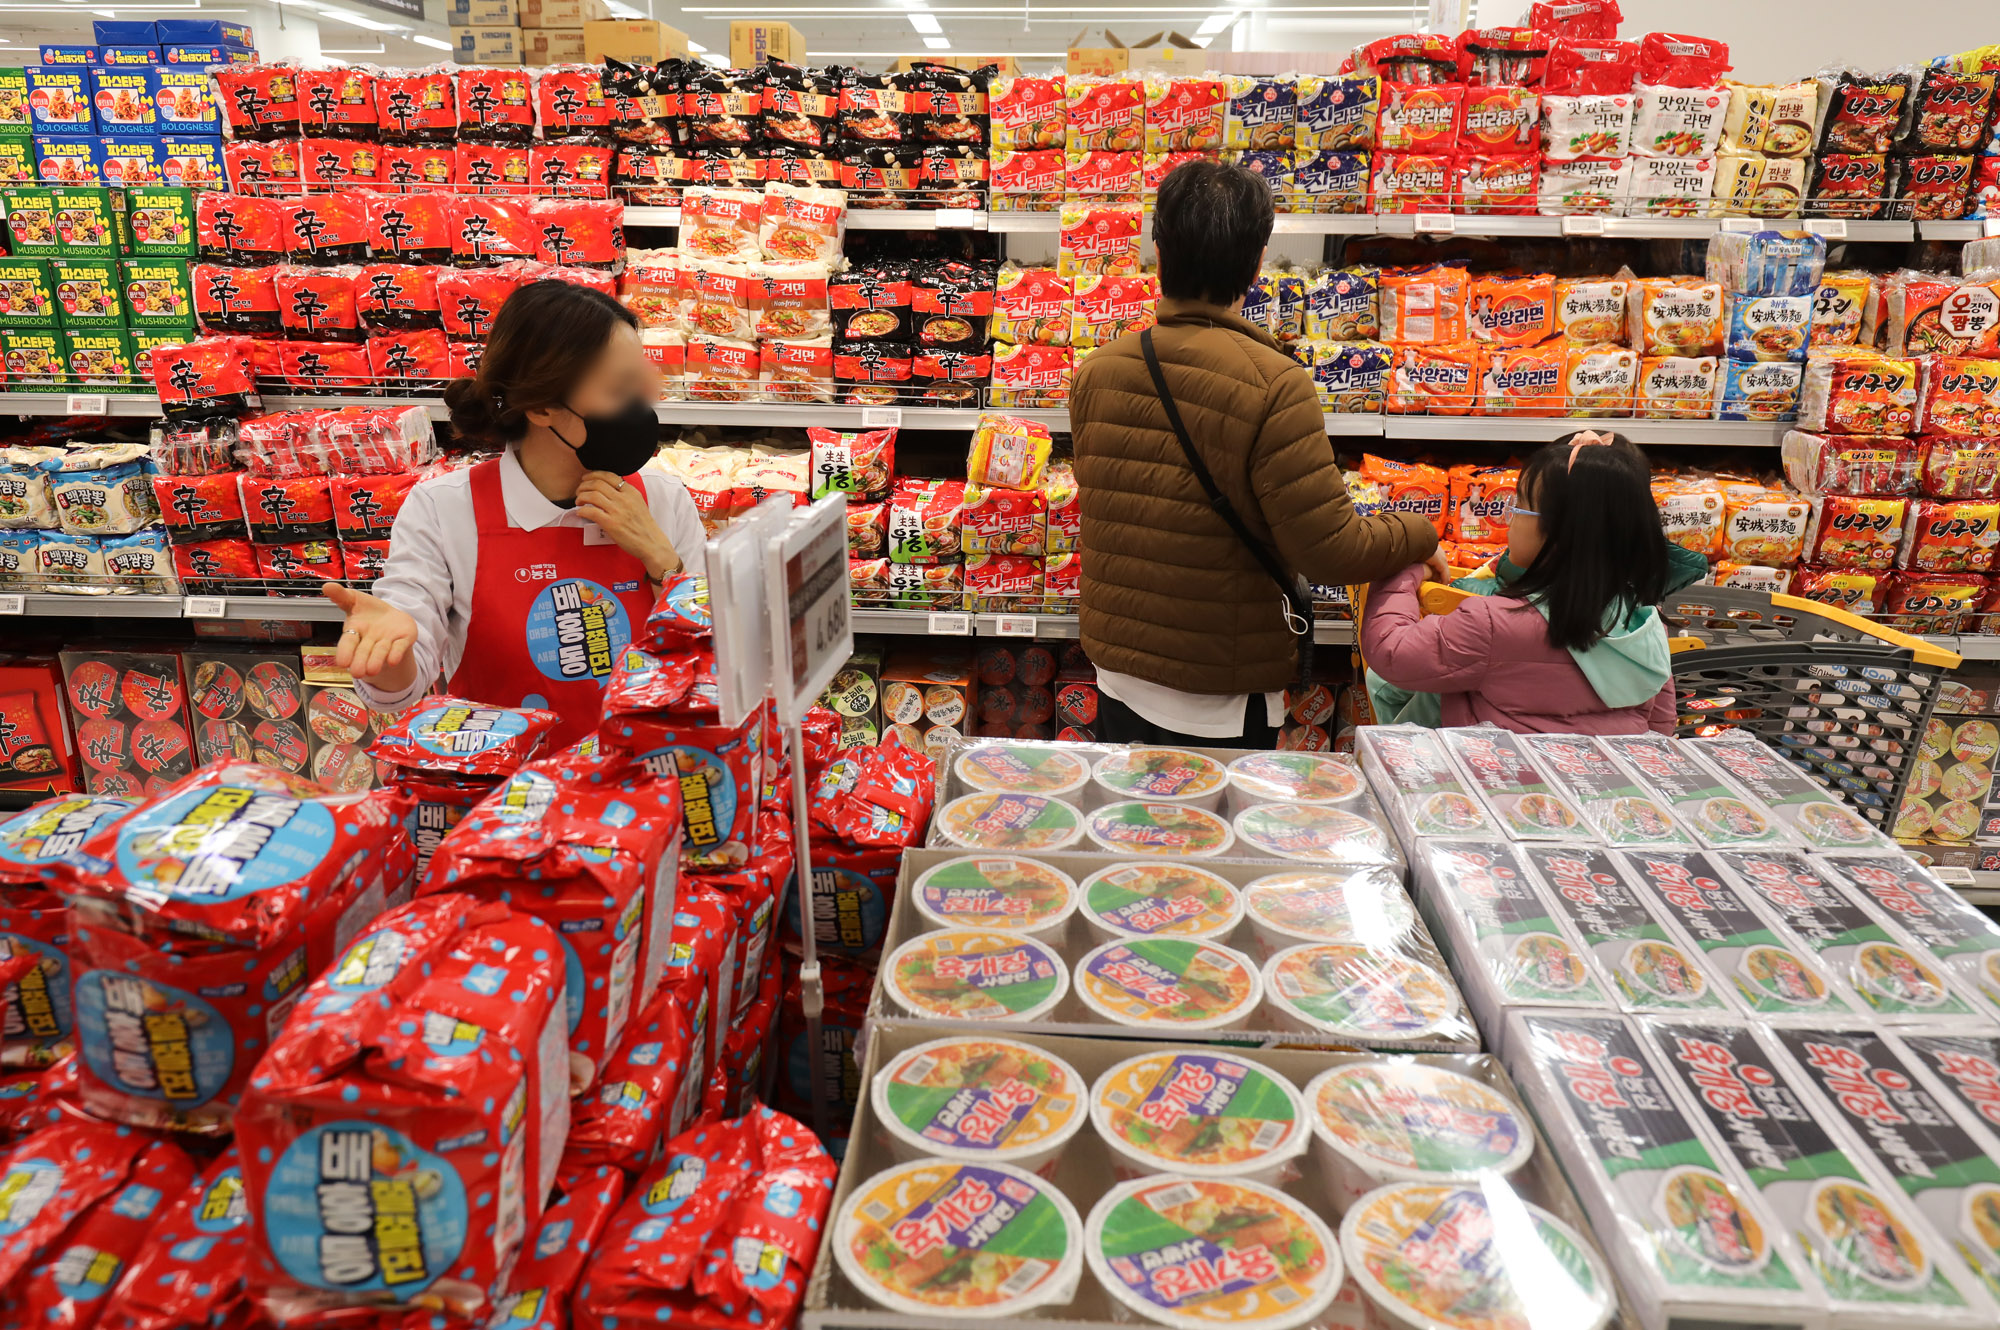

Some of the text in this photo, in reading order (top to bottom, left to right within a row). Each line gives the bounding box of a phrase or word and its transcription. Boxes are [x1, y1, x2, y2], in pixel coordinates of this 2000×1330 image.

[961, 93, 976, 103] 두부
[1659, 96, 1704, 111] 맛있는
[1932, 86, 1989, 106] 너구리
[962, 103, 978, 113] 김치
[1568, 100, 1613, 115] 맛있는
[1777, 104, 1803, 117] 짬뽕
[1846, 95, 1899, 116] 너구리
[1002, 100, 1055, 131] 진라면
[1075, 105, 1131, 135] 진라면
[1242, 101, 1294, 129] 진라면
[1307, 104, 1364, 133] 진라면
[1394, 107, 1452, 125] 삼양라면
[1595, 114, 1623, 128] 라면
[1684, 114, 1711, 128] 라면
[37, 124, 89, 132] BOLOGNESE
[102, 125, 154, 133] BOLOGNESE
[162, 123, 213, 131] BOLOGNESE
[1649, 160, 1692, 176] 맛있는
[1768, 167, 1791, 181] 짬뽕
[1828, 162, 1880, 182] 너구리
[1916, 163, 1970, 184] 너구리
[1387, 173, 1443, 189] 삼양라면
[1473, 174, 1532, 190] 삼양라면
[1589, 175, 1618, 190] 라면
[1674, 176, 1703, 191] 라면
[63, 246, 110, 255] MUSHROOM
[136, 246, 187, 254] MUSHROOM
[1073, 235, 1130, 260] 진라면
[651, 269, 675, 282] 건면
[712, 277, 736, 291] 건면
[781, 282, 806, 297] 건면
[1007, 295, 1061, 321] 진라면
[1086, 298, 1143, 325] 진라면
[1316, 294, 1369, 319] 진라면
[1567, 299, 1620, 314] 安城湯麵
[1654, 304, 1711, 318] 安城湯麵
[66, 317, 118, 326] MUSHROOM
[135, 317, 187, 326] MUSHROOM
[1483, 308, 1543, 328] 삼양라면
[1752, 309, 1802, 323] 安城湯麵
[1951, 318, 1985, 333] 짬뽕
[721, 351, 745, 364] 건면
[790, 348, 815, 362] 건면
[1006, 365, 1061, 391] 진라면
[1328, 370, 1381, 393] 진라면
[1408, 369, 1468, 385] 삼양라면
[1498, 372, 1557, 387] 삼양라면
[1577, 370, 1628, 385] 安城湯麵
[1651, 374, 1708, 389] 安城湯麵
[1746, 374, 1794, 389] 安城湯麵
[1844, 374, 1906, 395] 너구리
[1942, 374, 1998, 396] 너구리
[825, 451, 845, 463] 生生
[818, 465, 848, 489] 우동
[67, 490, 105, 506] 백짬뽕
[898, 515, 917, 527] 生生
[976, 513, 1033, 541] 진라면
[1736, 517, 1796, 534] 安城湯麵
[1833, 513, 1894, 533] 너구리
[1929, 518, 1990, 540] 너구리
[892, 529, 921, 554] 우동
[49, 550, 86, 565] 백짬뽕
[118, 553, 153, 569] 백짬뽕
[531, 570, 557, 580] 농심
[898, 565, 917, 576] 生生
[1805, 588, 1863, 605] 너구리
[1905, 597, 1963, 612] 너구리
[552, 584, 587, 675] 배홍동
[582, 606, 612, 676] 쫄쫄면
[338, 698, 359, 716] 건면
[1303, 691, 1325, 721] 새우탕
[942, 897, 1030, 913] 육개장
[934, 953, 1031, 978] 육개장
[1098, 962, 1190, 1006] 육개장
[1677, 1038, 1767, 1121] 육개장
[1804, 1043, 1909, 1126] 육개장
[1140, 1063, 1215, 1133] 육개장
[958, 1078, 1039, 1143] 육개장
[891, 1177, 997, 1258] 육개장
[1151, 1244, 1280, 1304] 육개장
